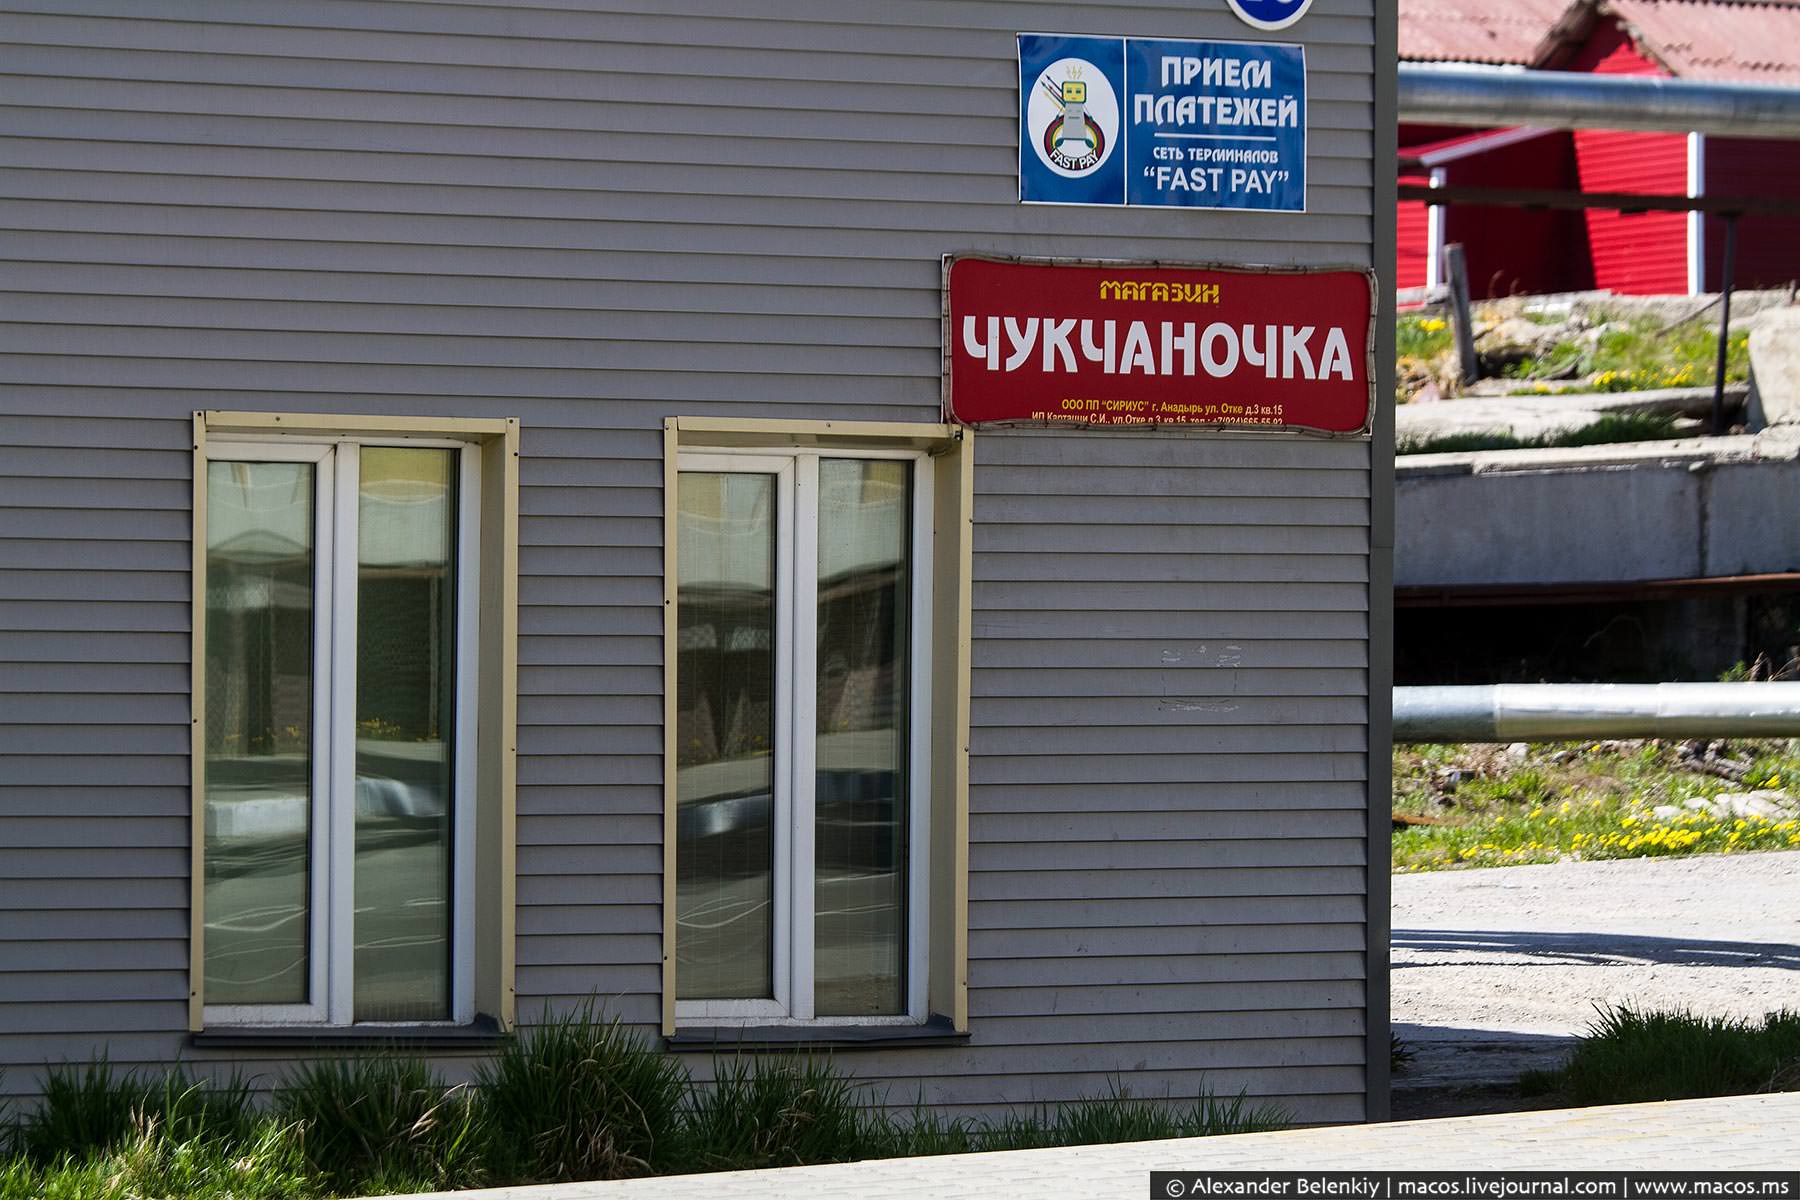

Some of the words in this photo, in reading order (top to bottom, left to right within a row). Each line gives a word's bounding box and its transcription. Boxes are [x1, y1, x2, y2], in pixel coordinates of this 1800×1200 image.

[1161, 56, 1272, 90] ПРИЕМ
[1134, 93, 1298, 128] ПЛАТЕЖЕЙ
[1050, 148, 1079, 170] FAST
[1079, 149, 1099, 169] PAY
[1153, 147, 1184, 161] СЕТЬ
[1188, 147, 1279, 164] ТЕРМИНАЛОВ
[1144, 166, 1224, 192] “FAST
[1231, 168, 1289, 194] PAY”
[1100, 280, 1220, 304] МАГАЗИН
[962, 315, 1354, 381] ЧУКЧАНОЧКА
[1062, 398, 1084, 410] ООО
[1086, 399, 1100, 411] ПП
[1151, 403, 1160, 412] г.
[1161, 401, 1204, 415] Анадырь
[1205, 404, 1219, 416] ул.
[1221, 403, 1243, 414] Отке
[1245, 403, 1259, 416] д.3
[1261, 404, 1283, 415] кв.15
